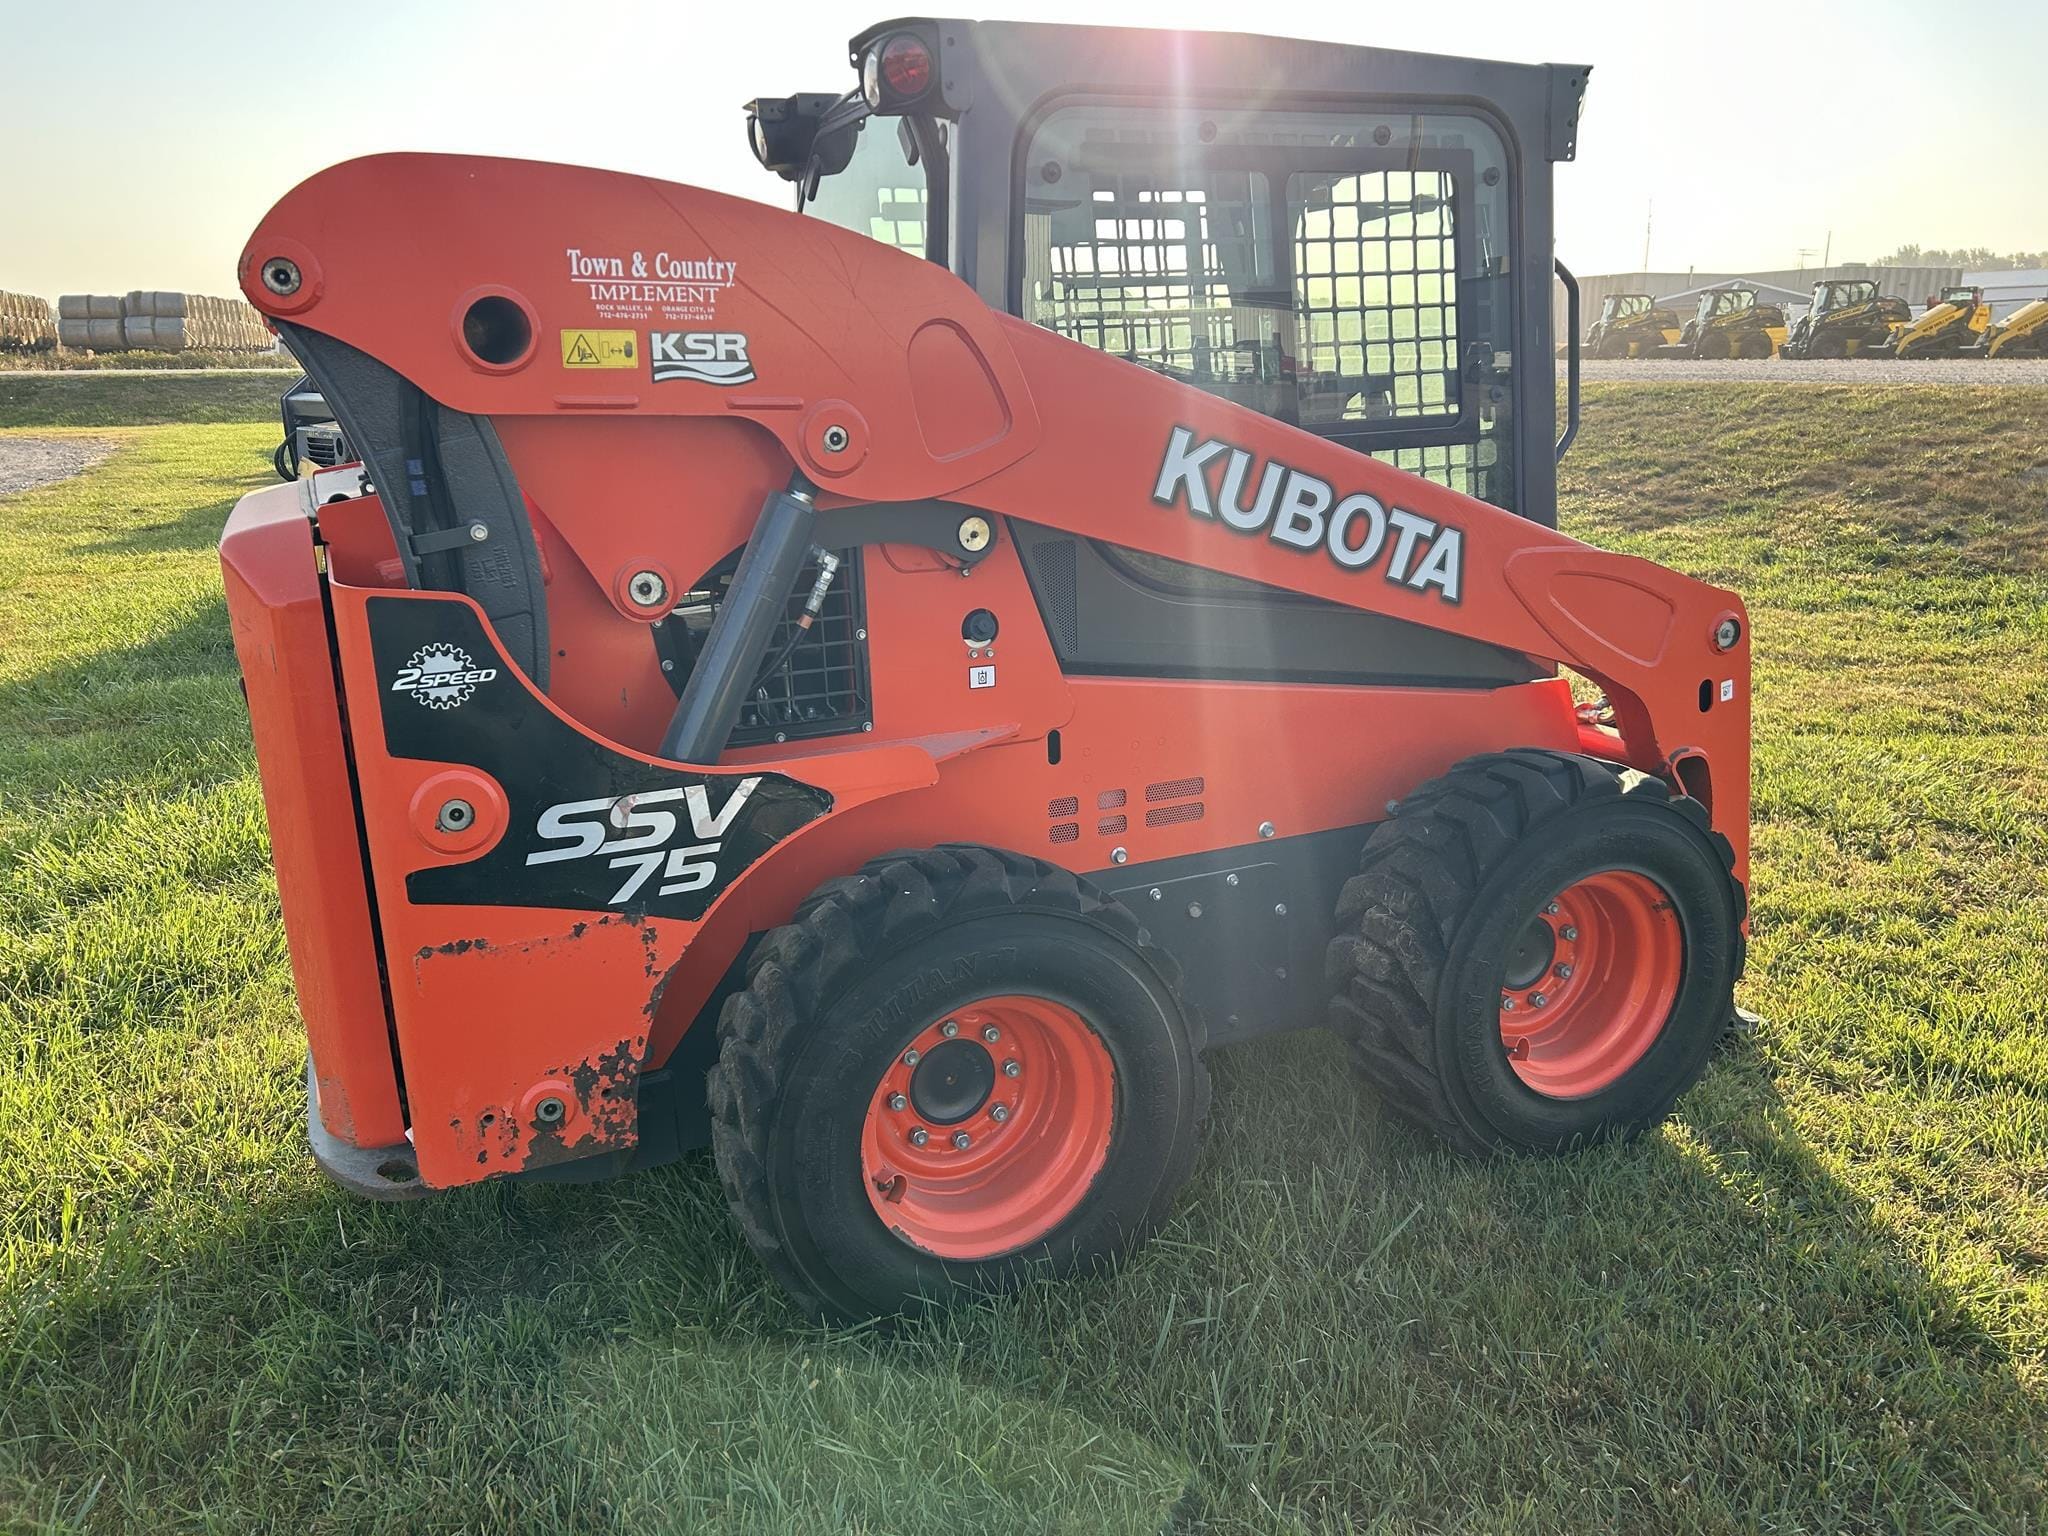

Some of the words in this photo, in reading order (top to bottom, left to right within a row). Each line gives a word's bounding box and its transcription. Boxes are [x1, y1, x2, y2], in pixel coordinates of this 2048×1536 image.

[567, 249, 624, 277] Town
[630, 251, 648, 277] &
[655, 252, 737, 288] Country
[590, 283, 719, 304] IMPLEMENT
[645, 304, 653, 312] IA
[662, 305, 688, 313] ORANGE
[650, 332, 748, 361] KSR
[1153, 426, 1463, 603] KUBOTA
[525, 775, 764, 867] SSV
[607, 842, 722, 906] 75
